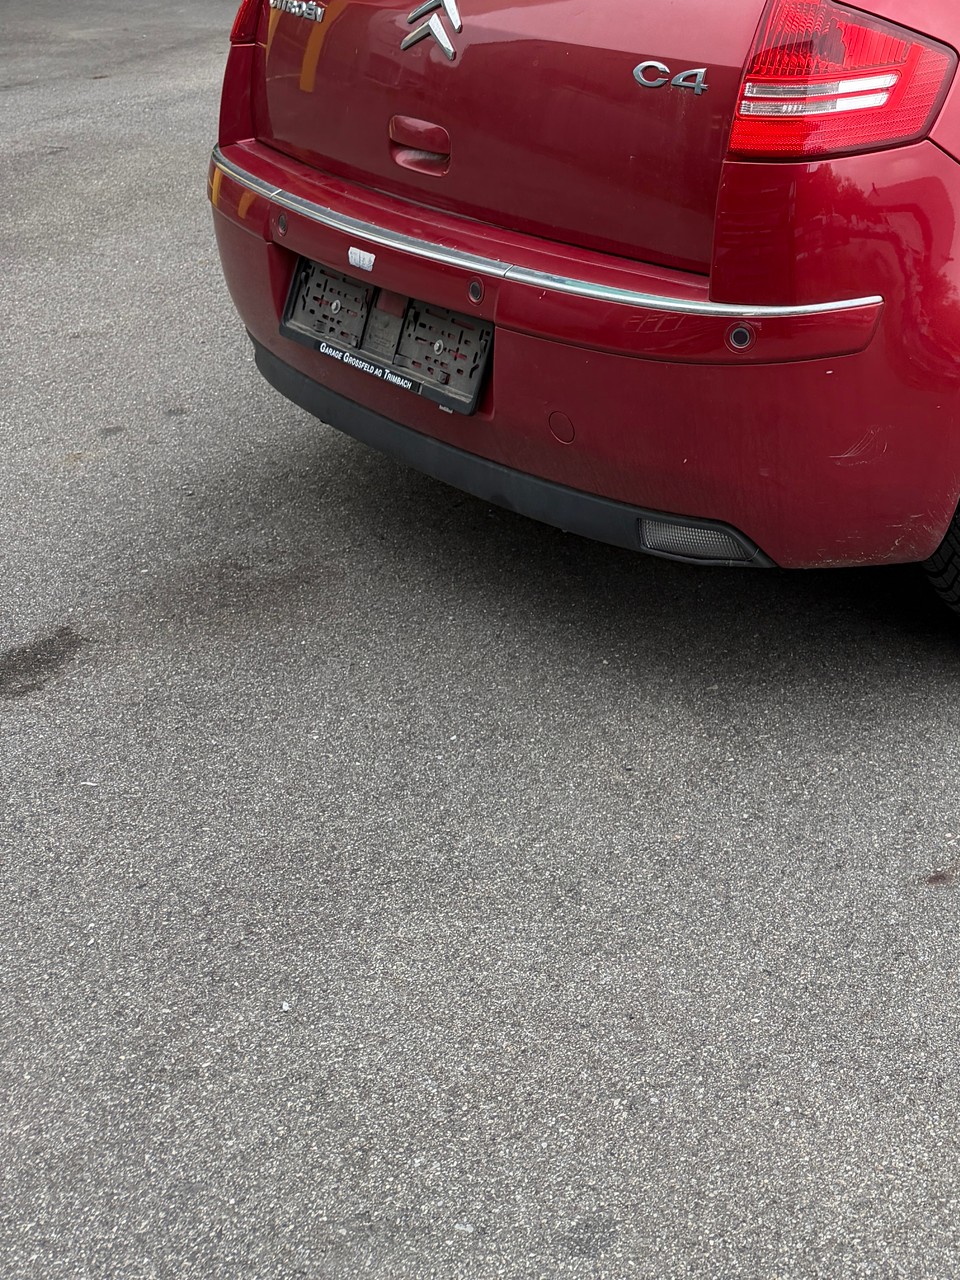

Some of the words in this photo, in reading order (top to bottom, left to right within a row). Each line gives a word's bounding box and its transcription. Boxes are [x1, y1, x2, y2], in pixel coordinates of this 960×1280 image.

[632, 60, 709, 95] C4
[320, 342, 343, 360] GARAGE
[343, 352, 374, 374] GROSSFELD
[383, 369, 412, 390] TRIMBACH
